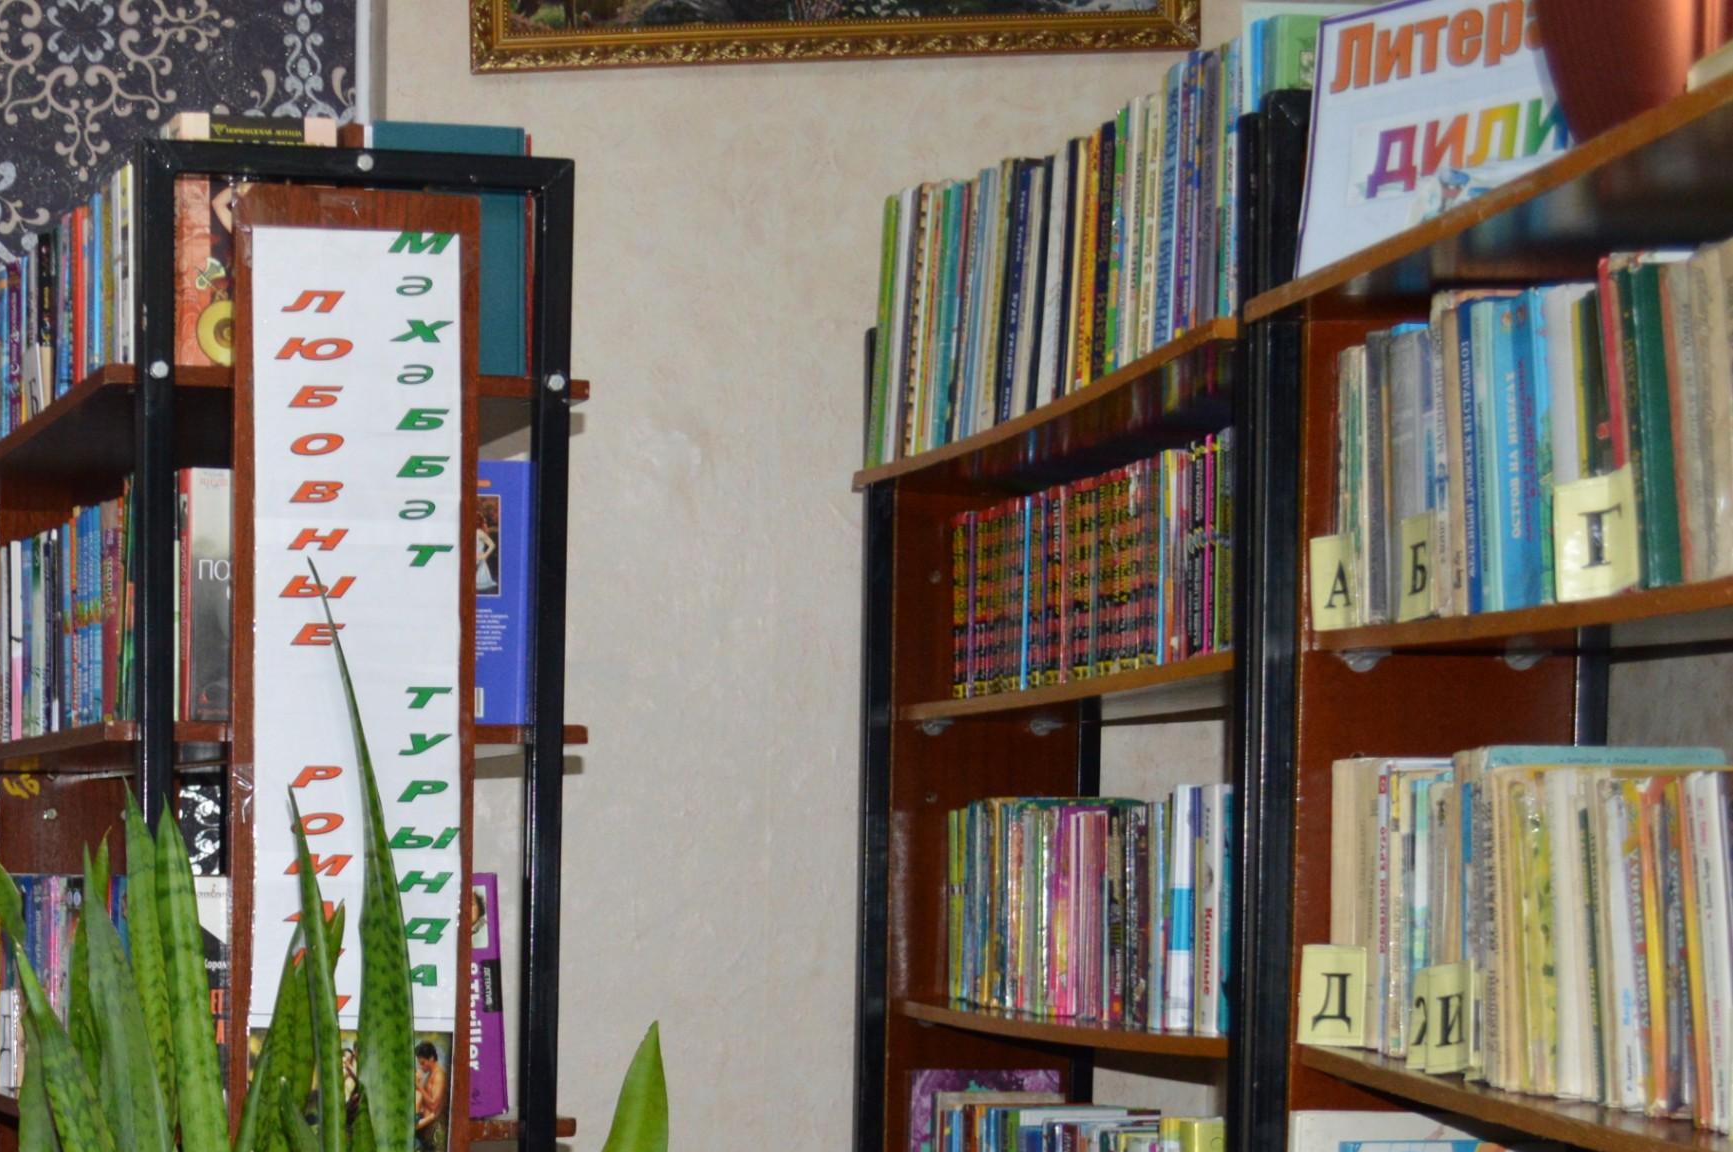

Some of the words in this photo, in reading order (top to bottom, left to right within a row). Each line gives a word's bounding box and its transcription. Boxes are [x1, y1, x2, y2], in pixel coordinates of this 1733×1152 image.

[274, 289, 357, 646] ЛЮБОВНЫЕ
[1577, 502, 1622, 569] Г
[1323, 559, 1353, 609] А
[1408, 540, 1428, 597] Б
[1311, 972, 1352, 1033] Д
[1435, 991, 1466, 1048] И
